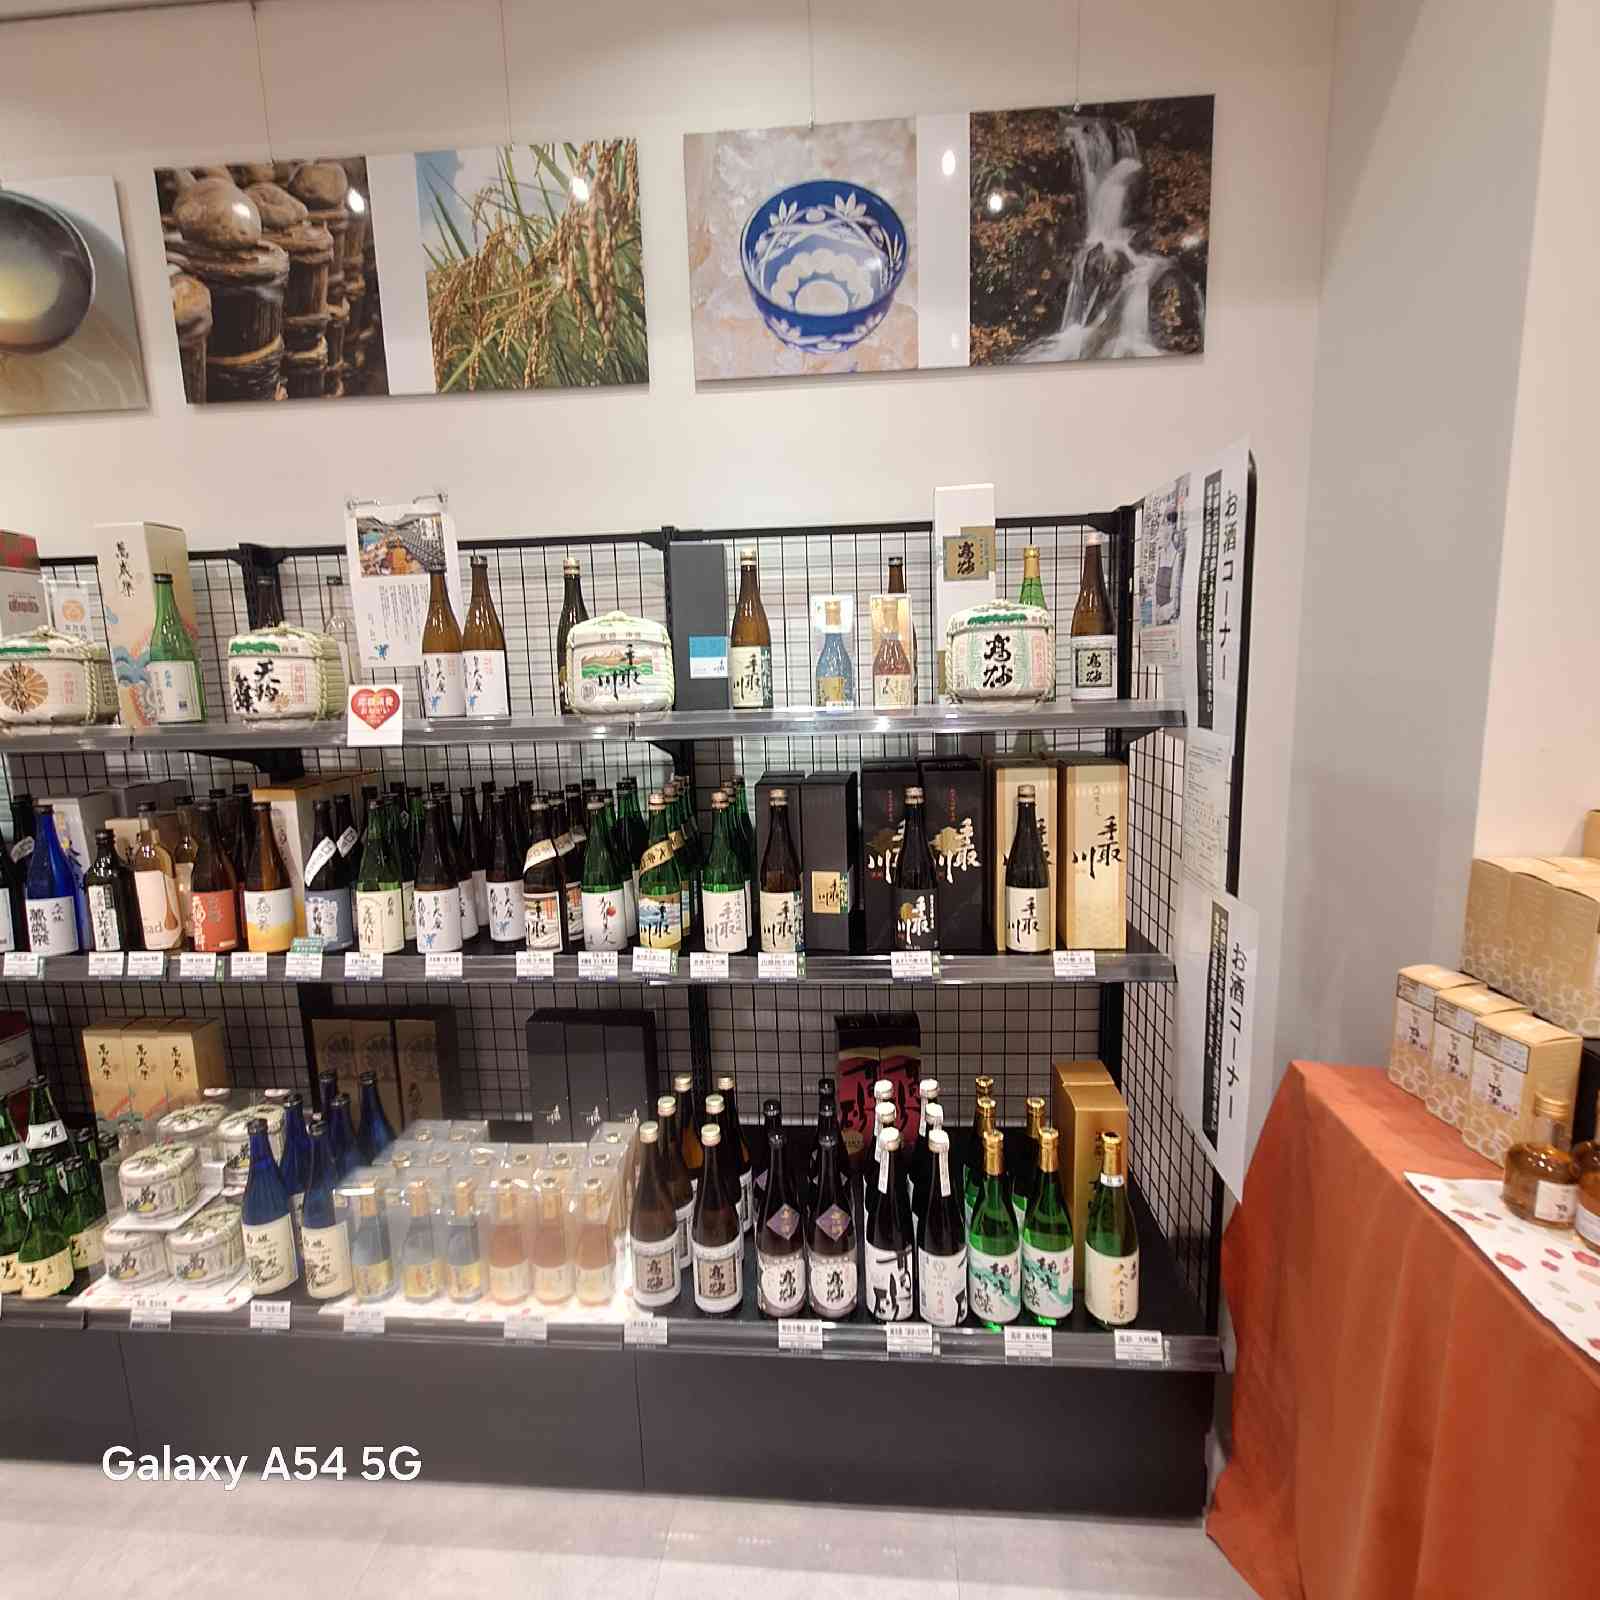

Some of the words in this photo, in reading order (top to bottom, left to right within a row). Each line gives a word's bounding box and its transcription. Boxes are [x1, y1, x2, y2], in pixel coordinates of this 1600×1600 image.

[1219, 490, 1238, 681] お酒コーナー
[599, 644, 641, 702] 手取川
[733, 654, 761, 700] 手取川
[1072, 815, 1126, 880] 手取川
[706, 901, 738, 948] 手取川
[763, 900, 795, 948] 手取川
[1008, 896, 1040, 944] 手取川
[1228, 942, 1248, 1119] お酒コーナー
